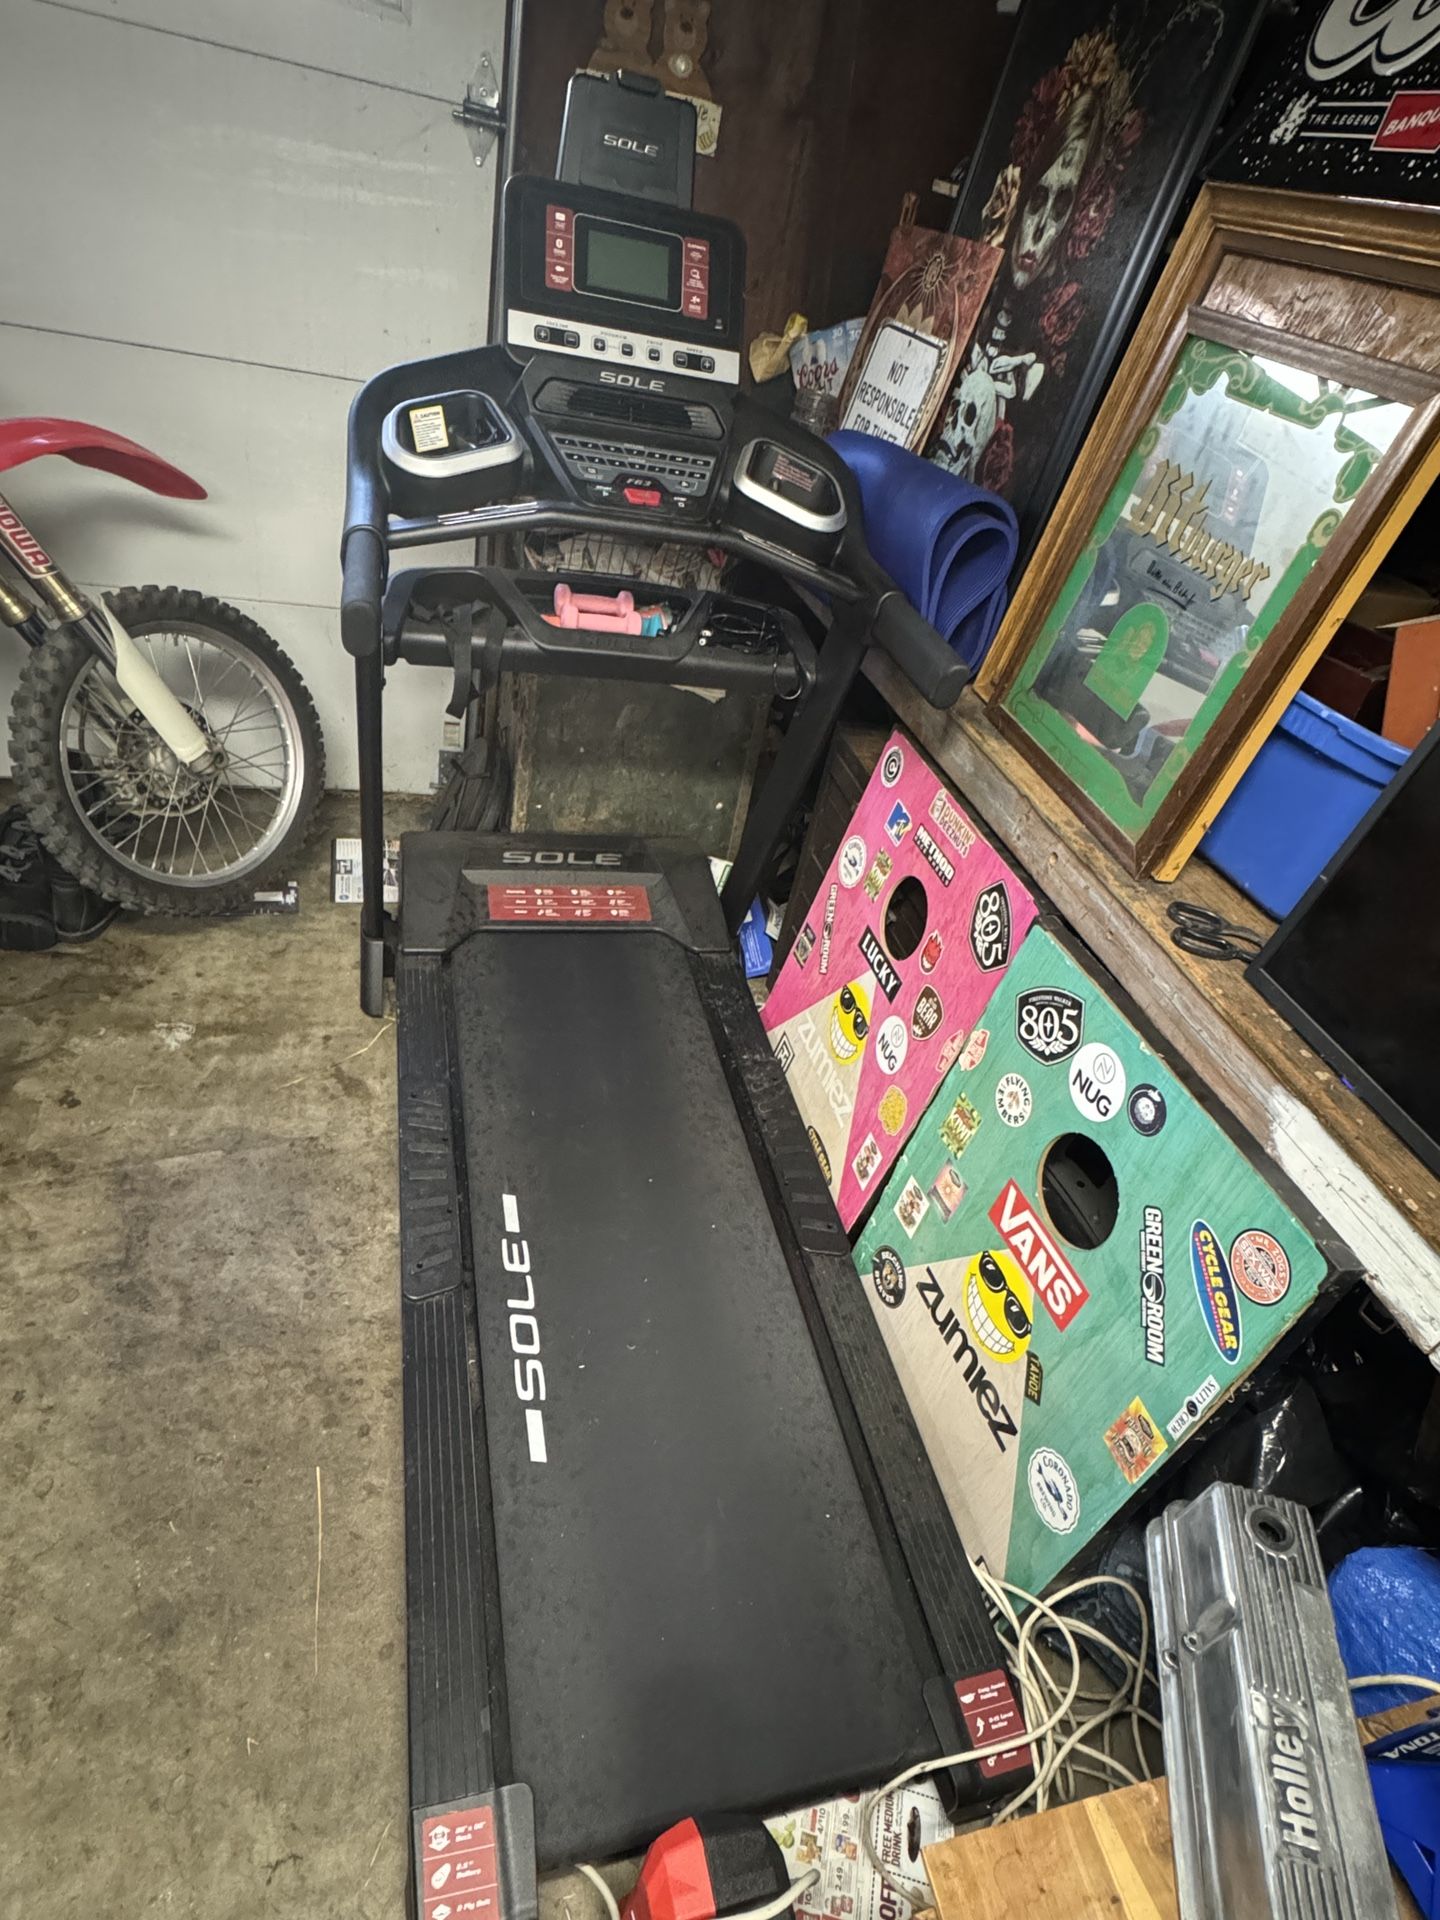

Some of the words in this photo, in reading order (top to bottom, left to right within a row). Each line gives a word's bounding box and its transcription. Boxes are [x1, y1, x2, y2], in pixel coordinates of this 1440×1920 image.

[1308, 113, 1331, 125] THE
[1332, 113, 1380, 126] LEGEND
[603, 133, 659, 157] SOLE
[599, 371, 666, 392] SOLE
[797, 357, 840, 390] Coors
[886, 360, 909, 386] NOT
[854, 414, 871, 435] FOR
[858, 381, 916, 431] RESPONSIBLE
[943, 804, 976, 846] DUNKIN'
[502, 851, 623, 866] SOLE
[916, 824, 956, 879] METHOD
[979, 890, 1002, 967] 805
[861, 933, 898, 994] LUCKY
[916, 997, 939, 1029] BEAR
[1019, 1004, 1080, 1046] 805
[877, 1032, 897, 1072] NUG
[997, 1086, 1026, 1125] EMBERS
[1005, 1075, 1031, 1107] FLYING
[1072, 1068, 1113, 1118] NUG
[1000, 1184, 1084, 1316] VANS
[1144, 1207, 1163, 1275] GREEN
[1239, 1239, 1260, 1265] SEX
[1257, 1263, 1279, 1295] WAX
[1273, 1247, 1287, 1279] ZOGS
[1199, 1229, 1224, 1289] CYCLE
[1214, 1290, 1239, 1351] GEAR
[501, 1237, 547, 1402] SOLE
[1146, 1302, 1165, 1365] ROOM
[915, 1266, 1019, 1454] zumiez
[1026, 1356, 1042, 1401] TAHOE
[1194, 1380, 1217, 1406] SALTY
[1170, 1413, 1190, 1434] CREW
[1041, 1455, 1074, 1512] CORONADO
[1271, 1708, 1322, 1853] Holley
[841, 1811, 850, 1835] 1.99
[880, 1838, 894, 1865] FREE
[890, 1831, 902, 1868] DRINK
[834, 1866, 844, 1892] 2.49
